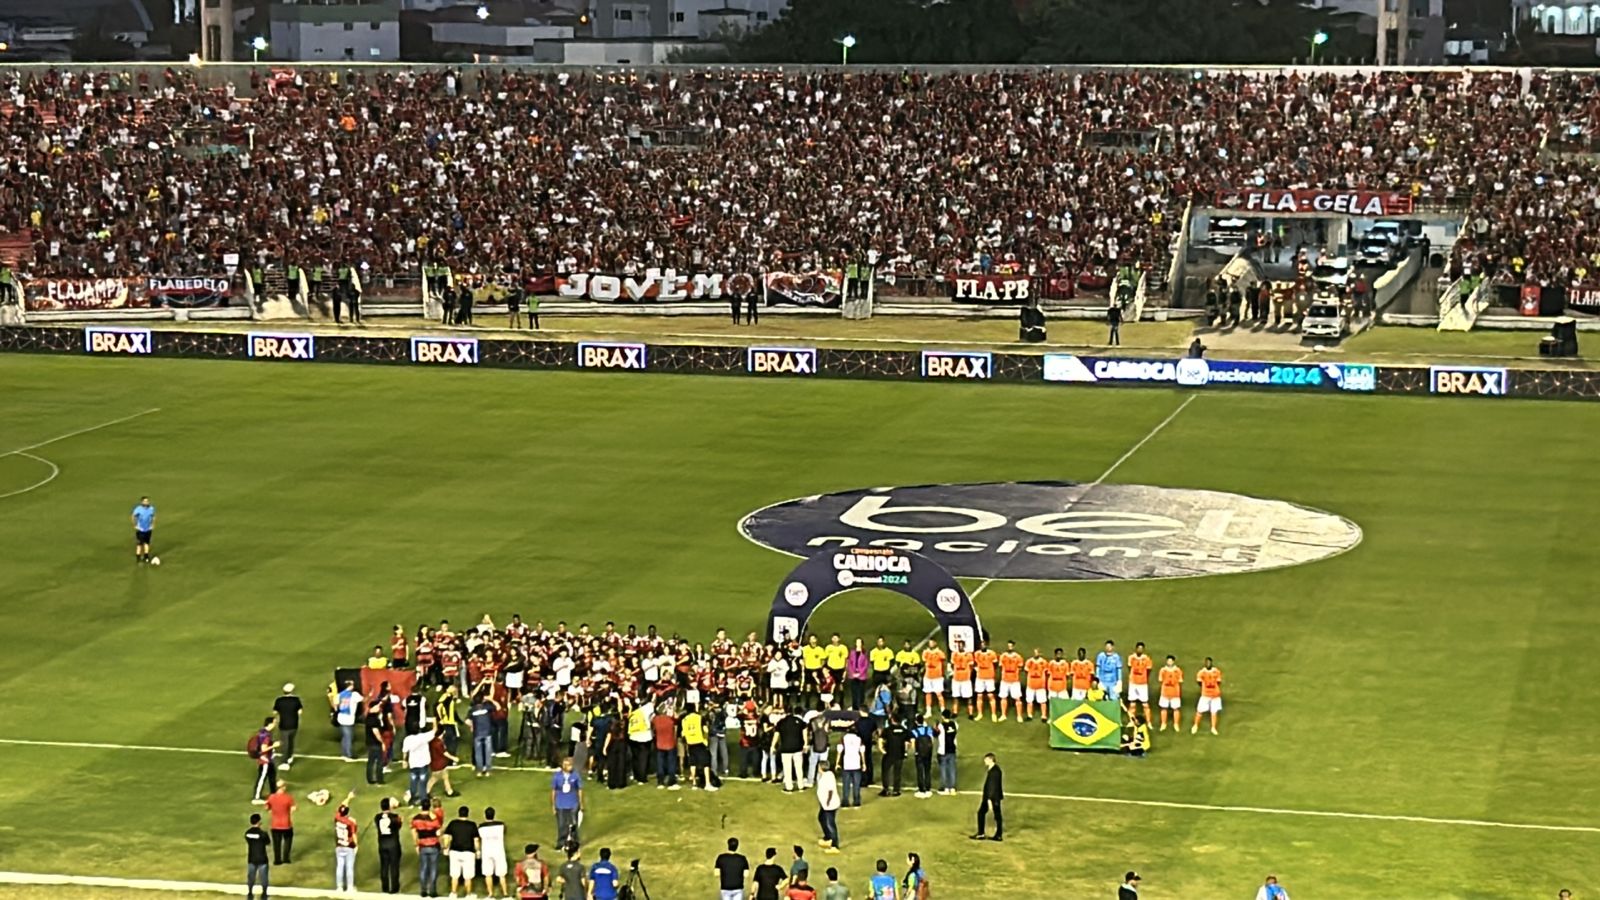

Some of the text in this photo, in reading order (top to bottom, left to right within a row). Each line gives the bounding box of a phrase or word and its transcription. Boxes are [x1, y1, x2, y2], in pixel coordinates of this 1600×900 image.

[149, 278, 229, 292] FLABEDELO
[558, 267, 725, 302] JOVEM
[955, 278, 1030, 301] FLA-PB
[92, 332, 145, 353] BRAX
[254, 337, 308, 359] BRAX
[417, 341, 474, 364] BRAX
[584, 347, 641, 369] BRAX
[754, 352, 811, 374] BRAX
[927, 357, 986, 379] BRAX
[1094, 360, 1176, 380] CARIOCA
[1270, 366, 1321, 385] 2024
[1437, 372, 1499, 395] BRAX
[838, 495, 1276, 545] bet
[832, 553, 912, 573] CARIOCA
[882, 574, 908, 584] 2024
